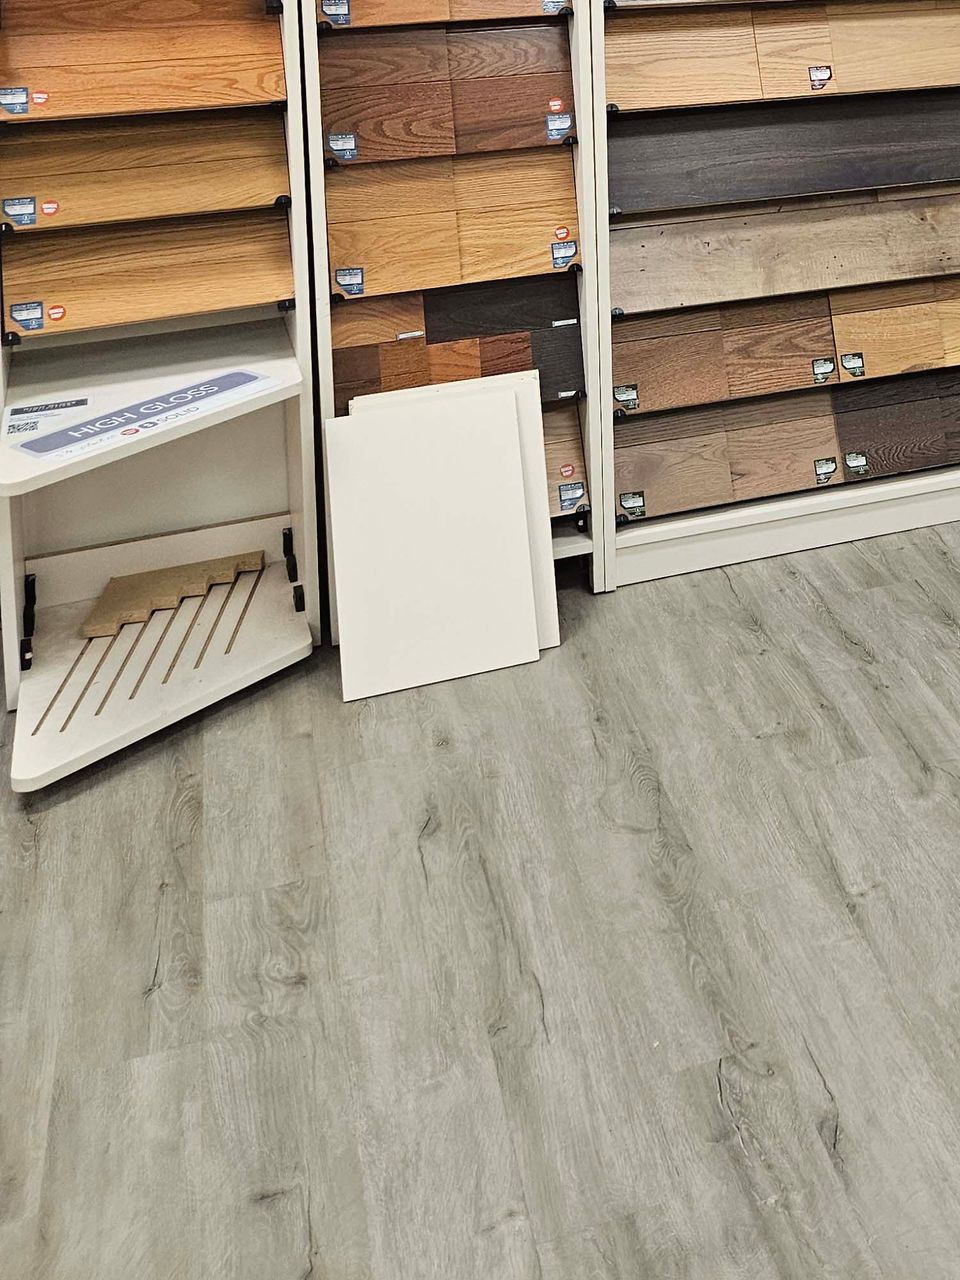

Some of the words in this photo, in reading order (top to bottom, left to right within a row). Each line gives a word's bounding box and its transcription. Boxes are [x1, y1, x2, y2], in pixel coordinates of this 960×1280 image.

[68, 412, 137, 438] HIGH
[139, 384, 219, 413] GLOSS
[156, 406, 200, 423] SOLID
